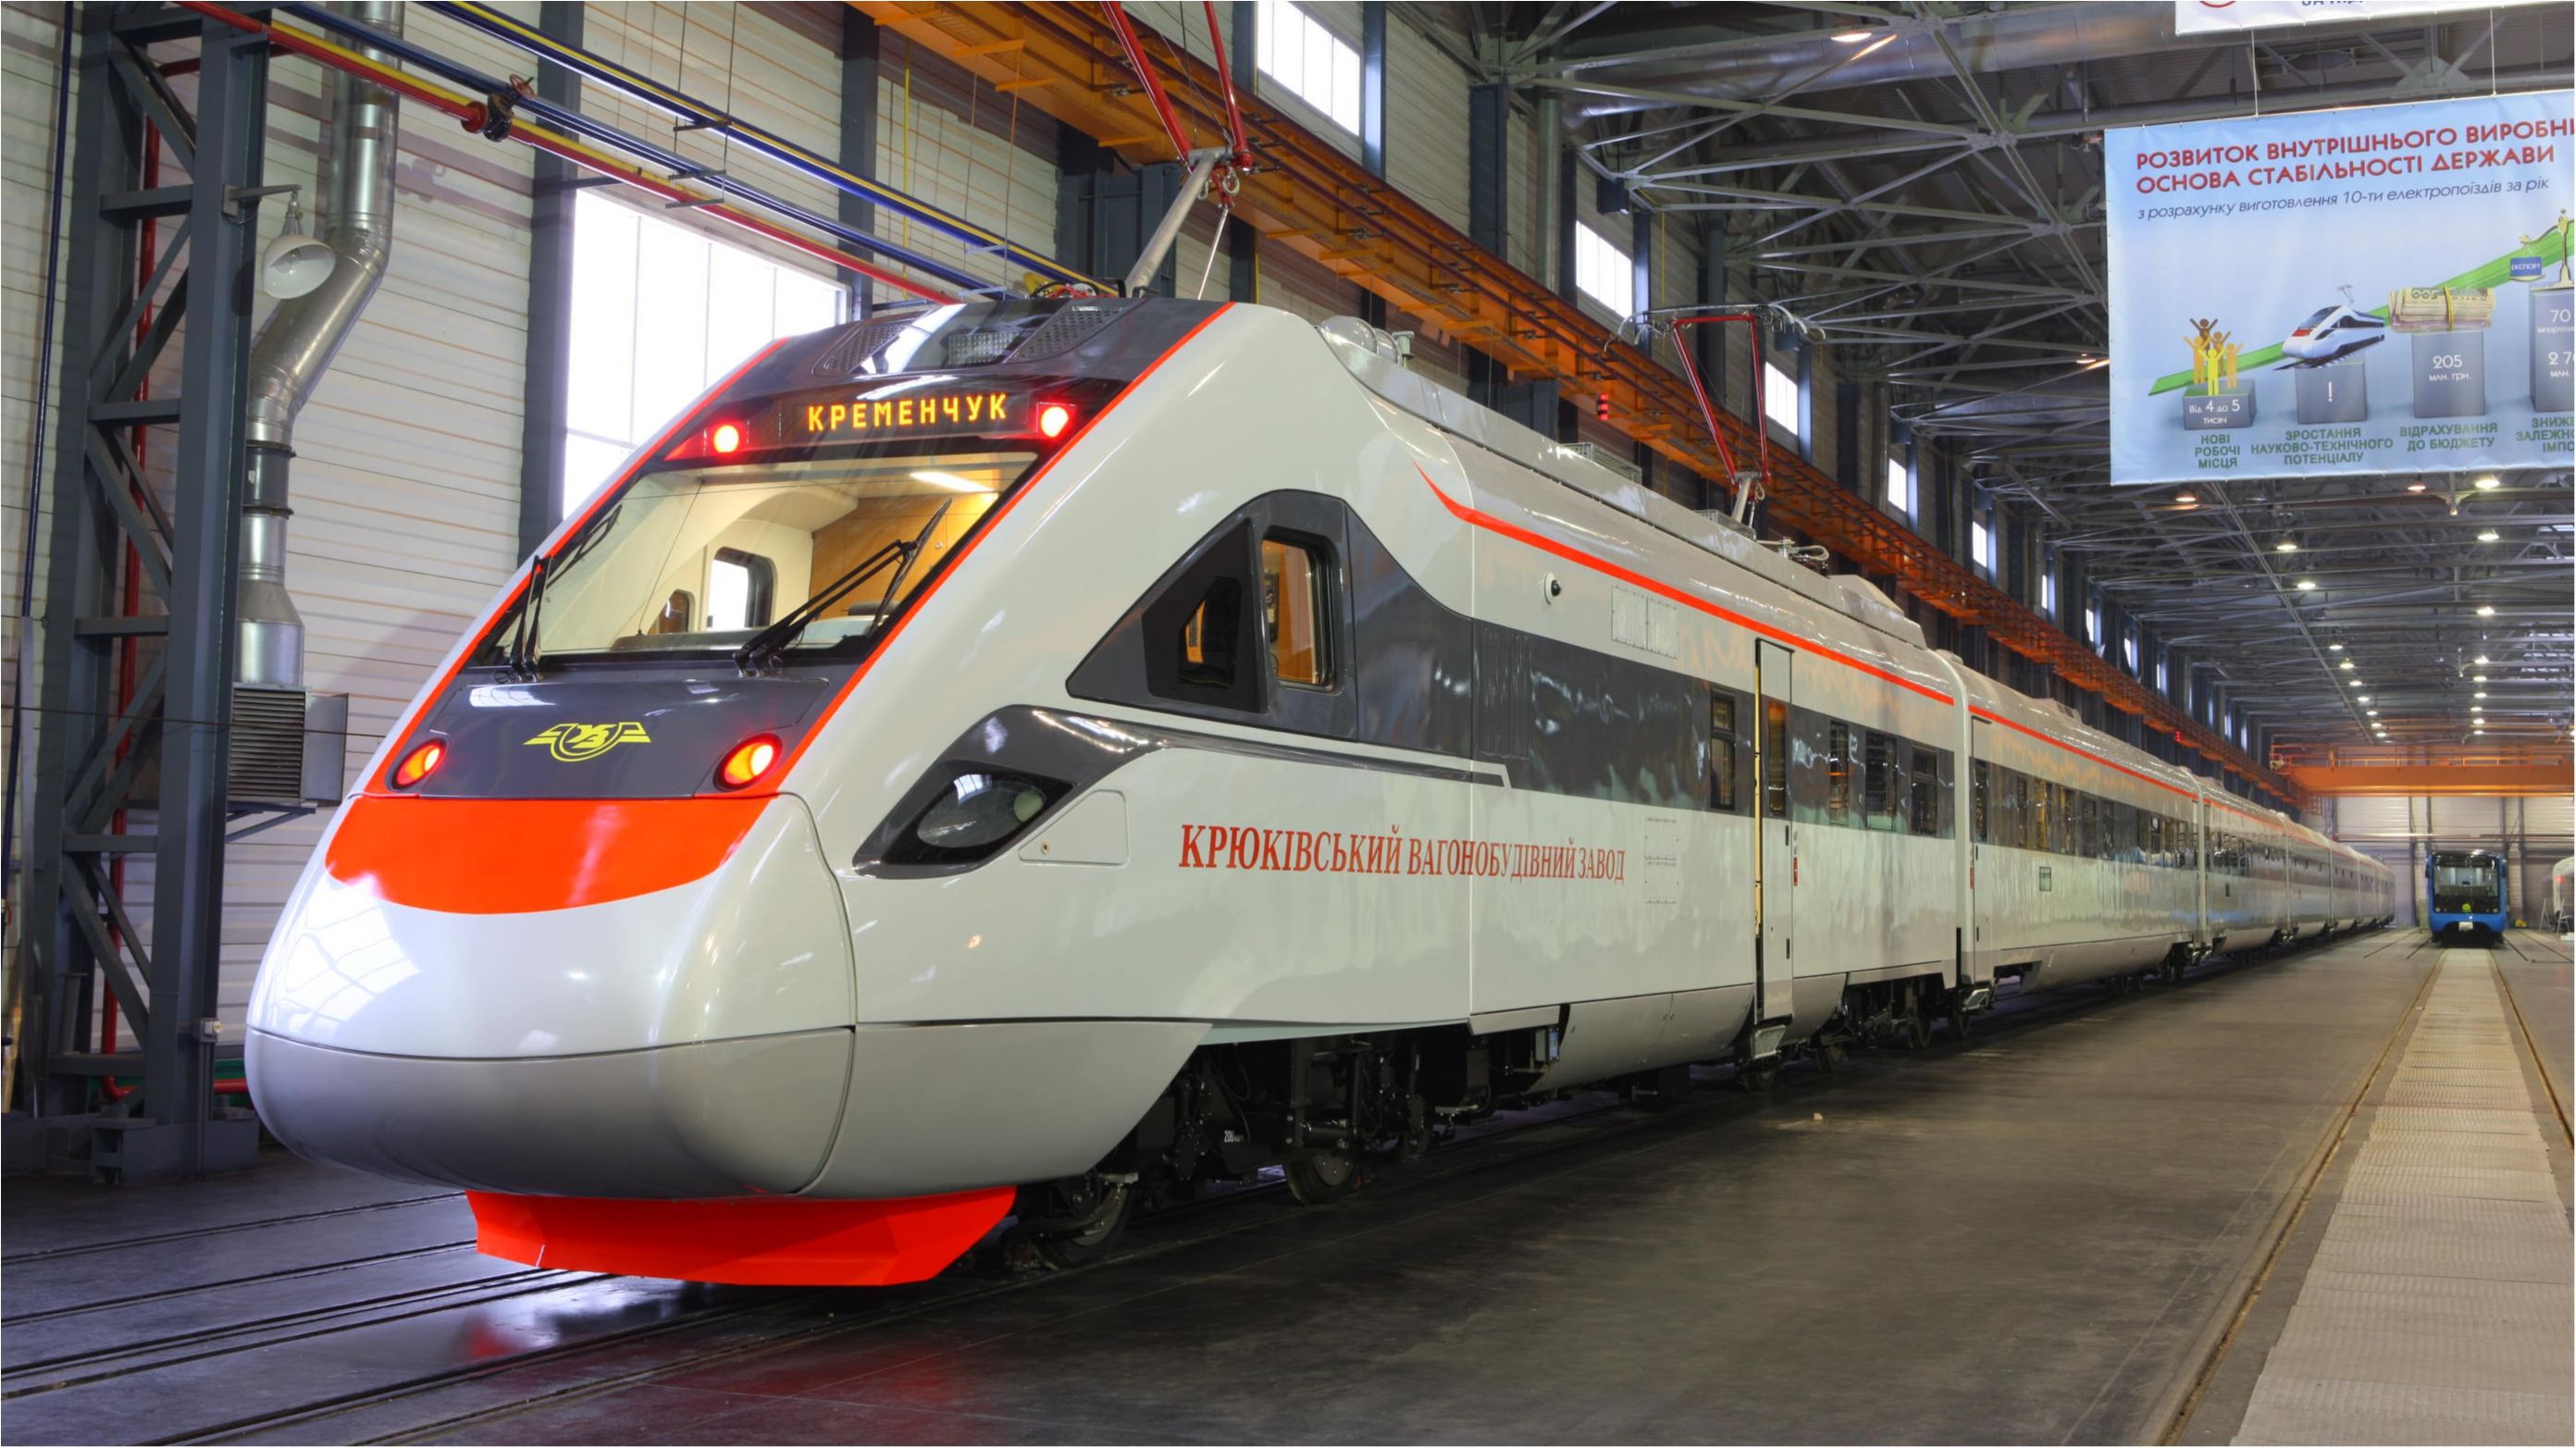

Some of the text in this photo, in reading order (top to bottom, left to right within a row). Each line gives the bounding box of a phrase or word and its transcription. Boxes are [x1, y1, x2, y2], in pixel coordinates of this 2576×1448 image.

[2136, 144, 2260, 169] РОЗВИТОК
[2266, 128, 2458, 160] ВНУТРІШНЬОГО
[2136, 144, 2555, 193] ОСНОВА СТАБІЛЬНОСТІ ДЕРЖАВИ
[2148, 203, 2235, 221] розрахунку
[2239, 194, 2338, 212] виготовлення
[2344, 191, 2383, 204] 10-ти
[2386, 181, 2502, 201] електропоїздів
[2506, 182, 2522, 192] за
[2525, 177, 2550, 193] рік
[2433, 354, 2463, 369] 205
[806, 392, 1008, 432] КРЕМЕНЧУК
[2205, 399, 2214, 413] 4
[2231, 399, 2241, 412] 5
[2285, 427, 2361, 441] ЗРОСТАННЯ
[2399, 422, 2498, 438] ВІДРАХУВАННЯ
[2200, 434, 2230, 444] НОВІ
[2250, 438, 2394, 454] НАУКОВО-ТЕХНІЧНОГО
[2407, 436, 2496, 452] ДО БЮДЖЕТУ
[2195, 445, 2240, 457] РОБОЧІ
[2284, 452, 2364, 465] ПОТЕНЦІАЛУ
[2198, 457, 2237, 469] МІСЦЯ
[1178, 823, 1627, 885] КРЮКІВСЬКИЙ ВАГОНОБУДІВНИЙ ЗАВОД
